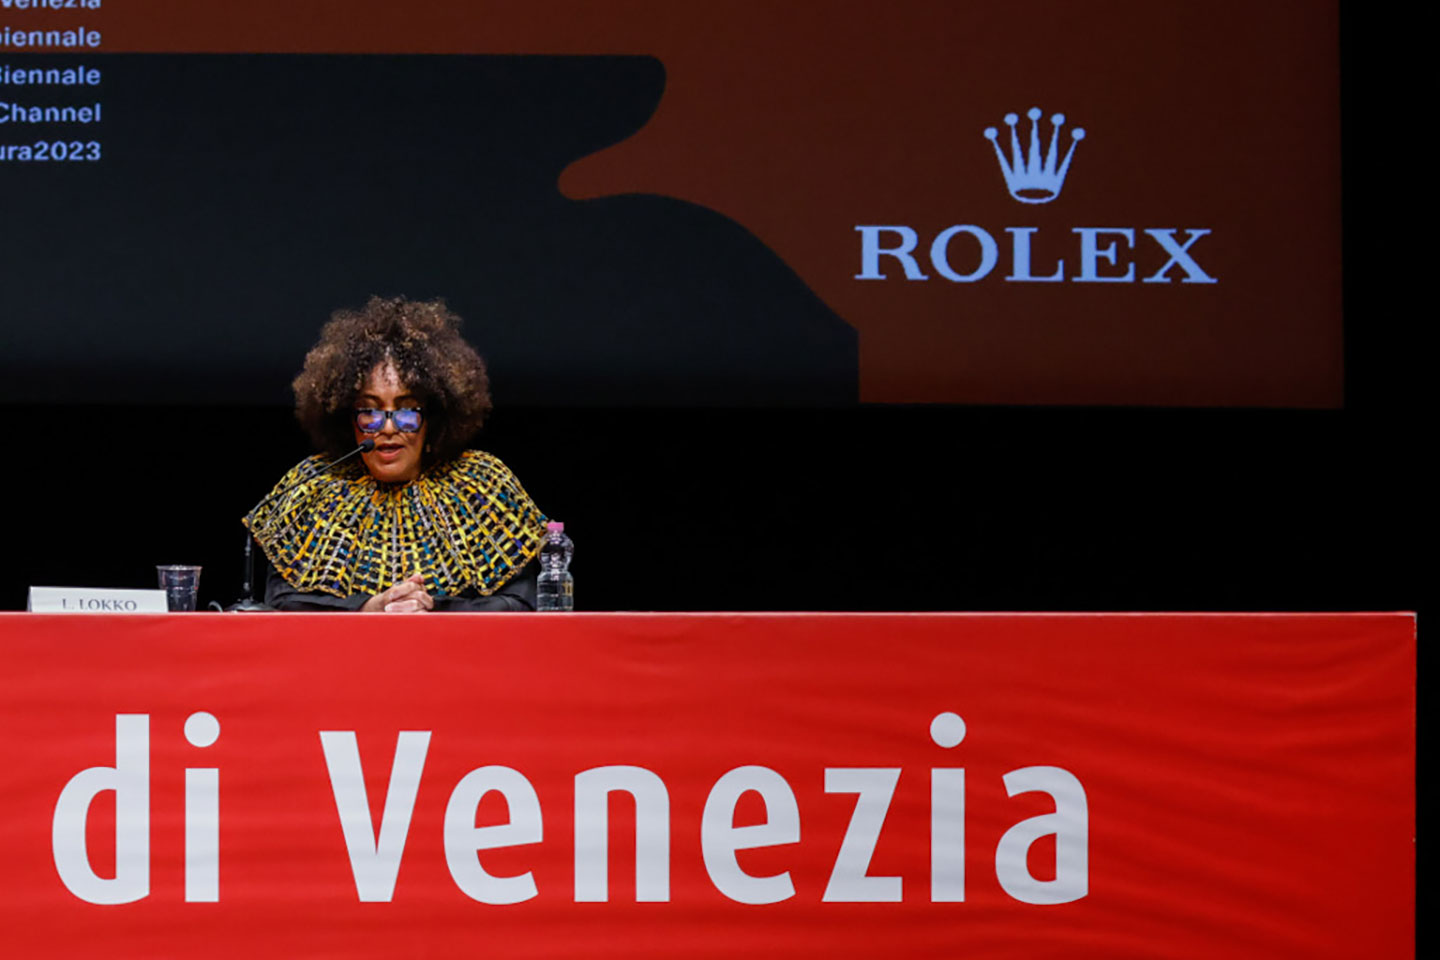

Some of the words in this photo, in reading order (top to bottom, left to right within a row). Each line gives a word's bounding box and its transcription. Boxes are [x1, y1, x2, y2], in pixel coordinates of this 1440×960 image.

[855, 225, 1218, 283] ROLEX
[78, 598, 138, 611] LOKKO
[53, 712, 220, 904] di
[320, 713, 1088, 904] Venezia
